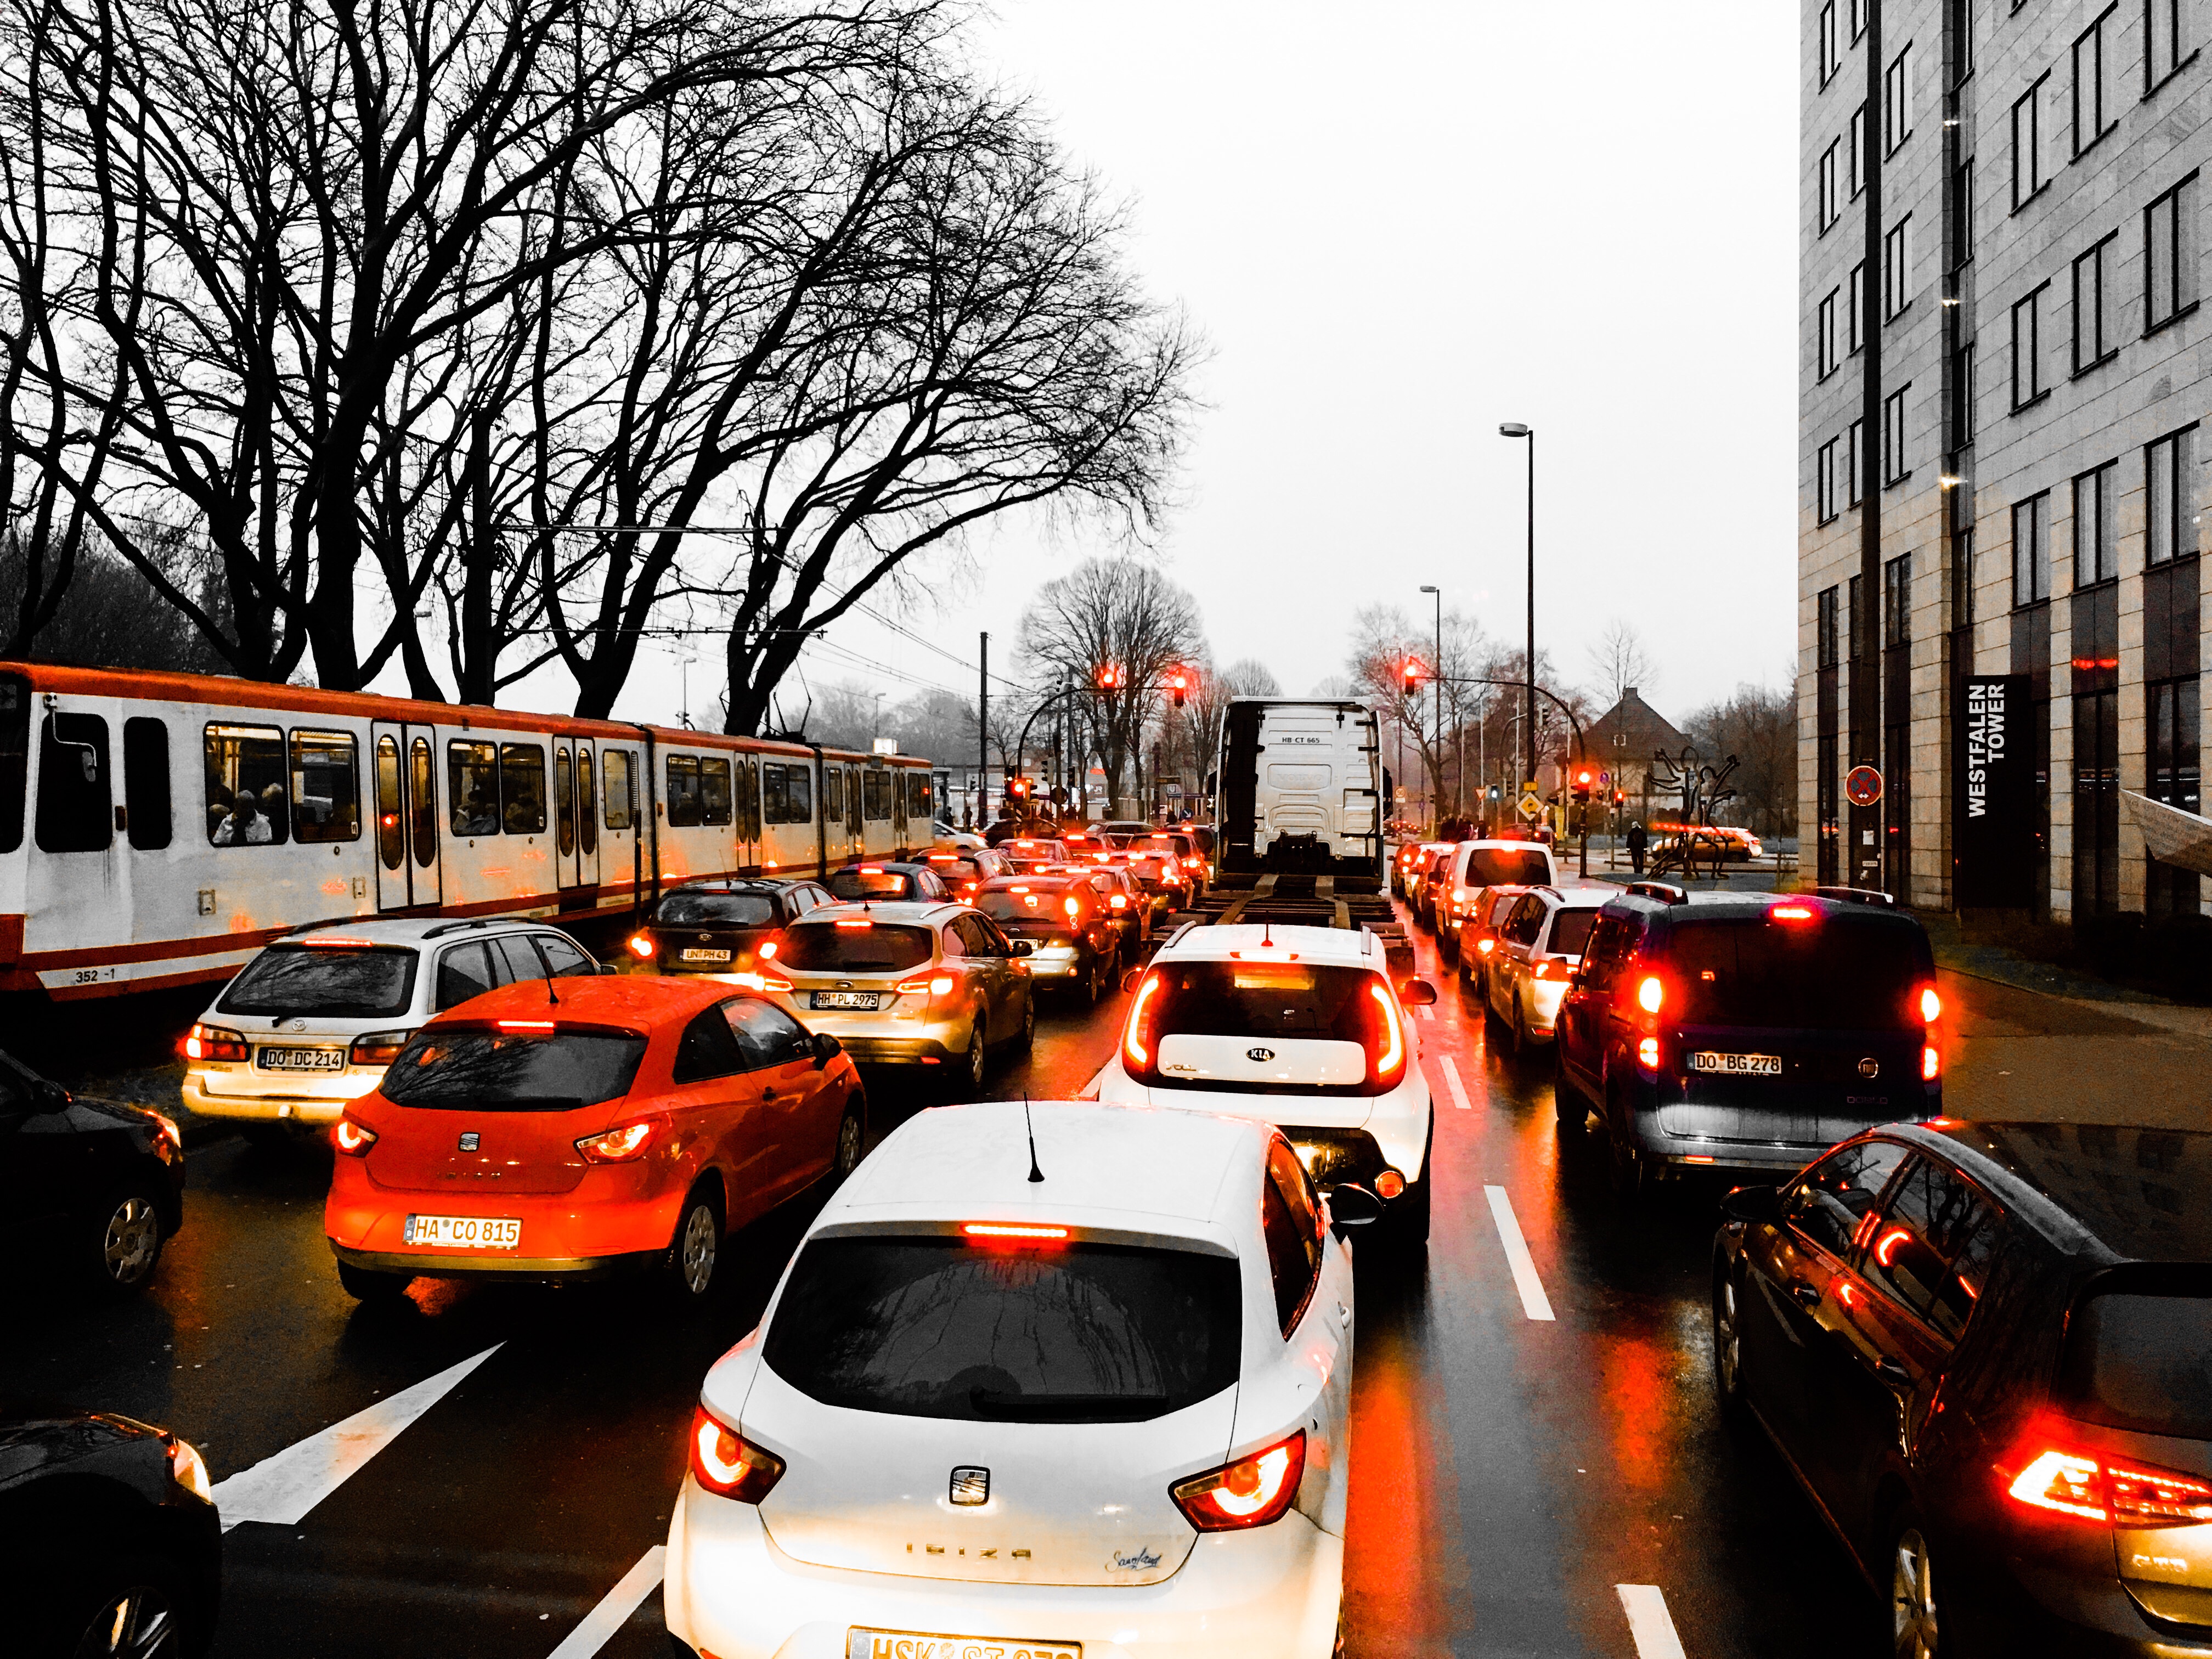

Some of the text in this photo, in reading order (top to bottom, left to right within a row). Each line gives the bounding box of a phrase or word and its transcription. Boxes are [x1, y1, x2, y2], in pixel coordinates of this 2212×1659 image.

[1988, 684, 2005, 763] TOWER
[1968, 685, 1985, 817] WESTFALEN
[687, 950, 727, 959] UN PH 43
[76, 968, 115, 983] 352 -1
[818, 994, 877, 1005] HH PL 2975
[268, 1051, 339, 1066] DO DC 214
[1251, 1049, 1271, 1060] KIA
[1696, 1054, 1780, 1072] DO BG 278
[415, 1219, 517, 1242] HA CO 815
[906, 1542, 1031, 1560] IBIZA
